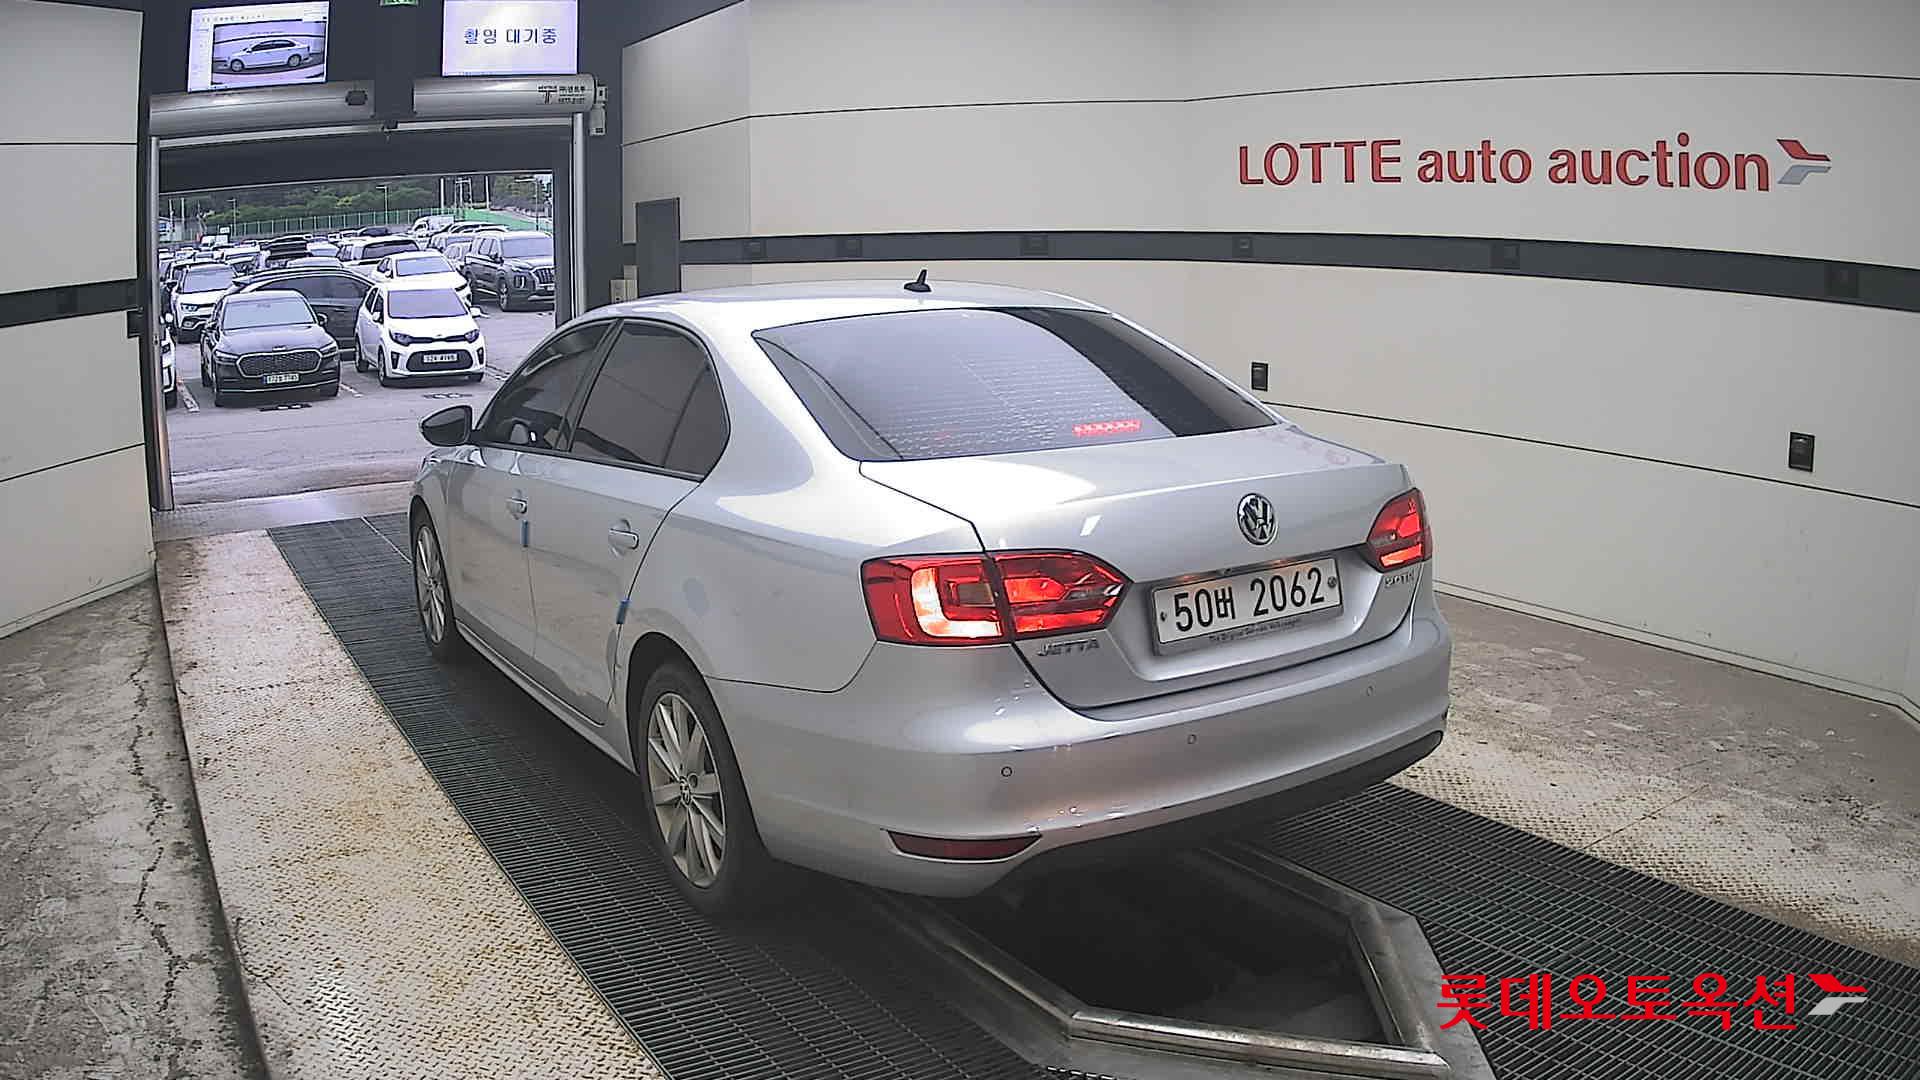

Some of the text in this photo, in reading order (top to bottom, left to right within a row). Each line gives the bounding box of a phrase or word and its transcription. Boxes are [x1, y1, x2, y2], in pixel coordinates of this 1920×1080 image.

[505, 28, 557, 45] 대기중
[1238, 132, 1771, 192] LOTTE auto auction
[1174, 586, 1236, 632] 50버
[1250, 567, 1325, 617] 2062
[1037, 637, 1101, 657] JETTA
